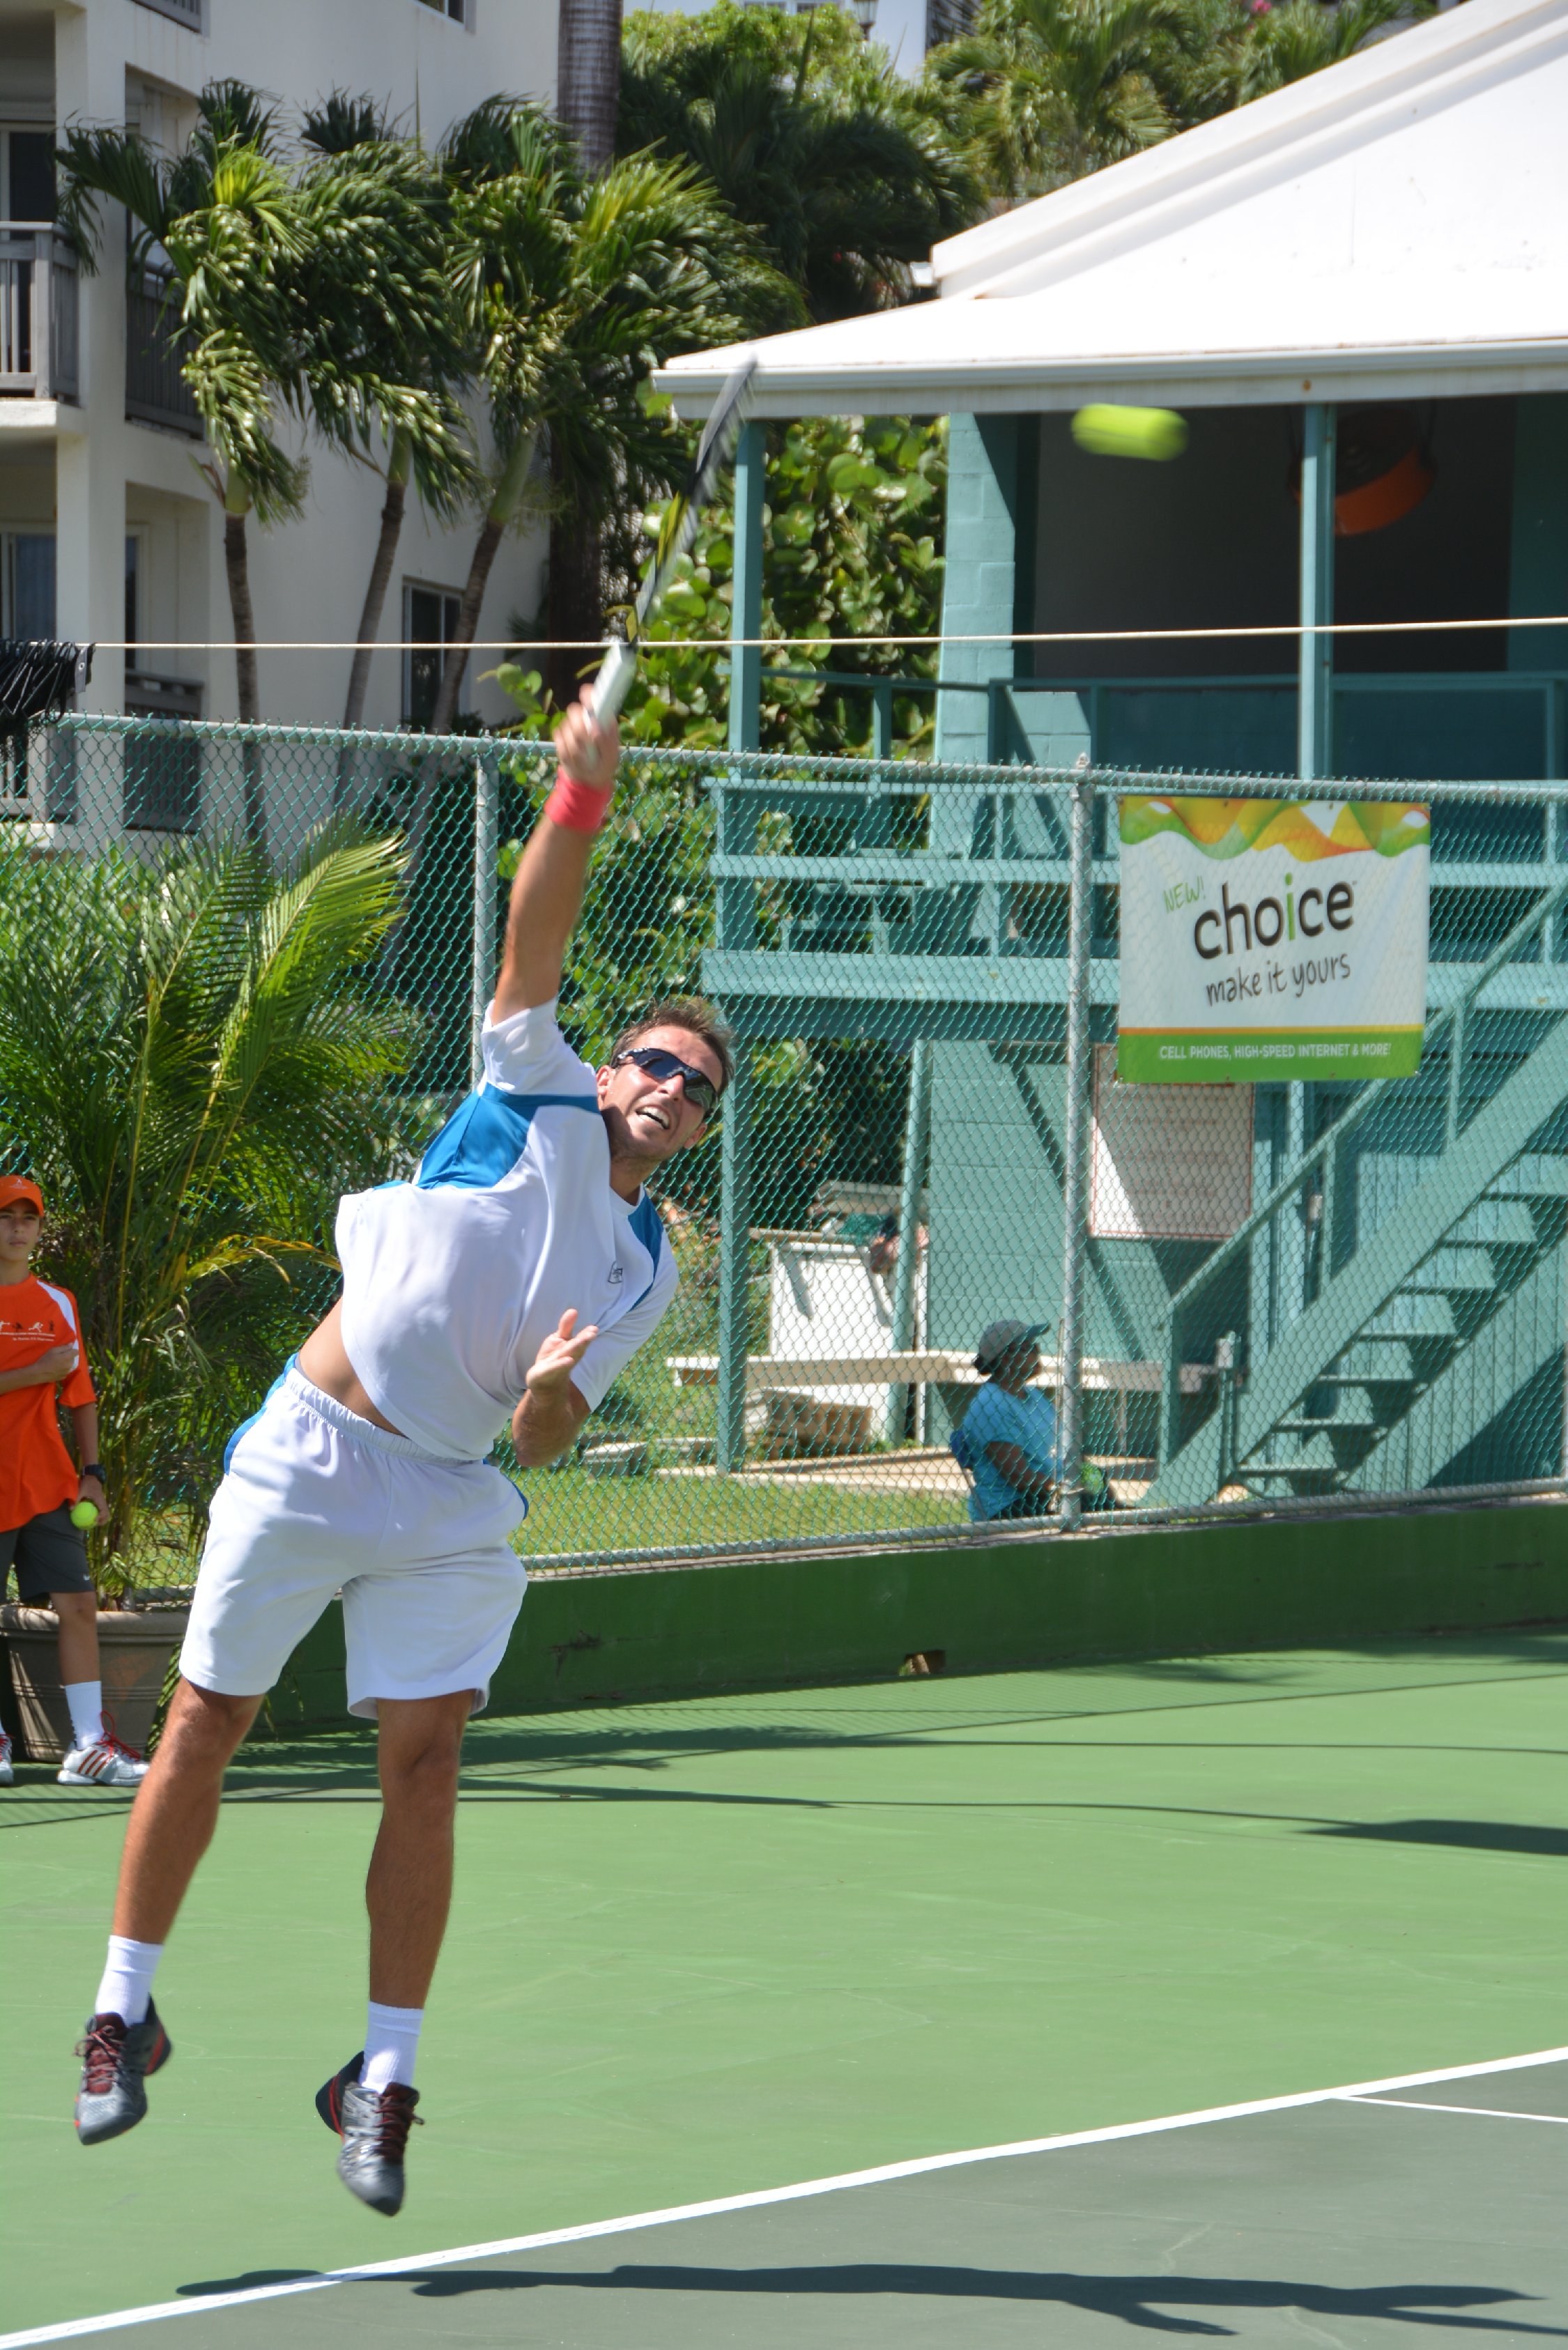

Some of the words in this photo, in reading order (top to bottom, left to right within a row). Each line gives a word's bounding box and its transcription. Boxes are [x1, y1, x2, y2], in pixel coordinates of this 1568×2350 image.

[1163, 875, 1206, 914] NEW!
[1194, 873, 1354, 960] choice
[1206, 967, 1261, 1007] make
[1266, 960, 1287, 994] it
[1291, 953, 1351, 998] yours
[1160, 1045, 1187, 1059] CELL
[1190, 1045, 1231, 1061] PHONES,
[1234, 1045, 1296, 1059] HIGH-SPEED
[1299, 1044, 1350, 1058] INTERNET
[1352, 1043, 1359, 1057] &
[1362, 1043, 1391, 1056] MORE!
